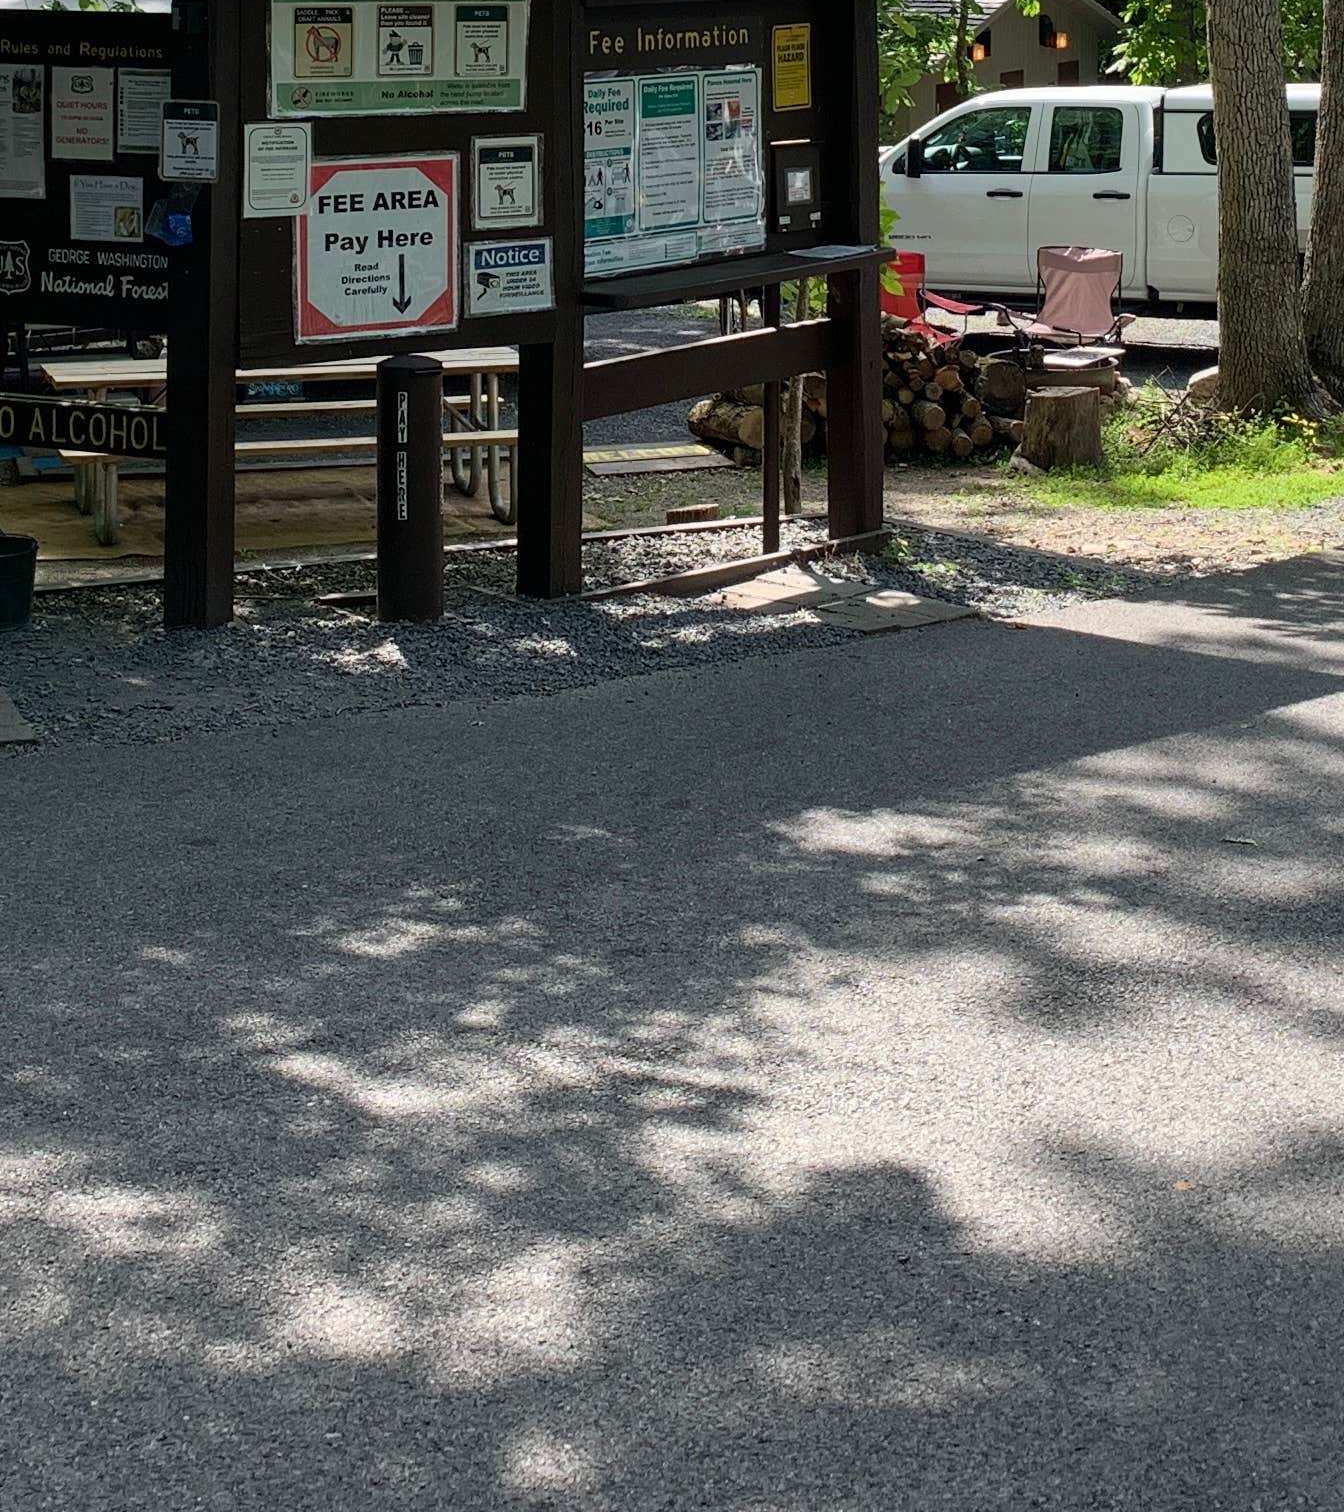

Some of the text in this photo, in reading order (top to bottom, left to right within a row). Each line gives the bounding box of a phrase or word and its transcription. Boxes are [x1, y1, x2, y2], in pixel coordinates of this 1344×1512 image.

[588, 25, 750, 55] Fee Information
[0, 39, 163, 60] Rules and Regulations
[777, 51, 805, 64] HAZARD
[381, 89, 434, 99] No Alcohol
[588, 88, 606, 99] Daily
[56, 100, 108, 110] QUIET HOURS
[183, 107, 200, 116] PETS
[584, 98, 629, 116] Required
[76, 127, 88, 135] NO
[584, 120, 602, 136] 16
[498, 151, 515, 159] PETS
[318, 189, 439, 214] FEE AREA
[325, 229, 433, 255] Pay Here
[47, 248, 90, 265] GEORGE
[96, 251, 169, 270] WASHINGTON
[481, 248, 540, 267] Notice
[354, 262, 379, 272] Read
[40, 271, 169, 300] National Forest
[341, 273, 391, 285] Directions
[344, 285, 388, 296] Carefully
[397, 391, 408, 443] PAY
[28, 406, 167, 452] ALCOHOL
[397, 451, 408, 521] HERE
